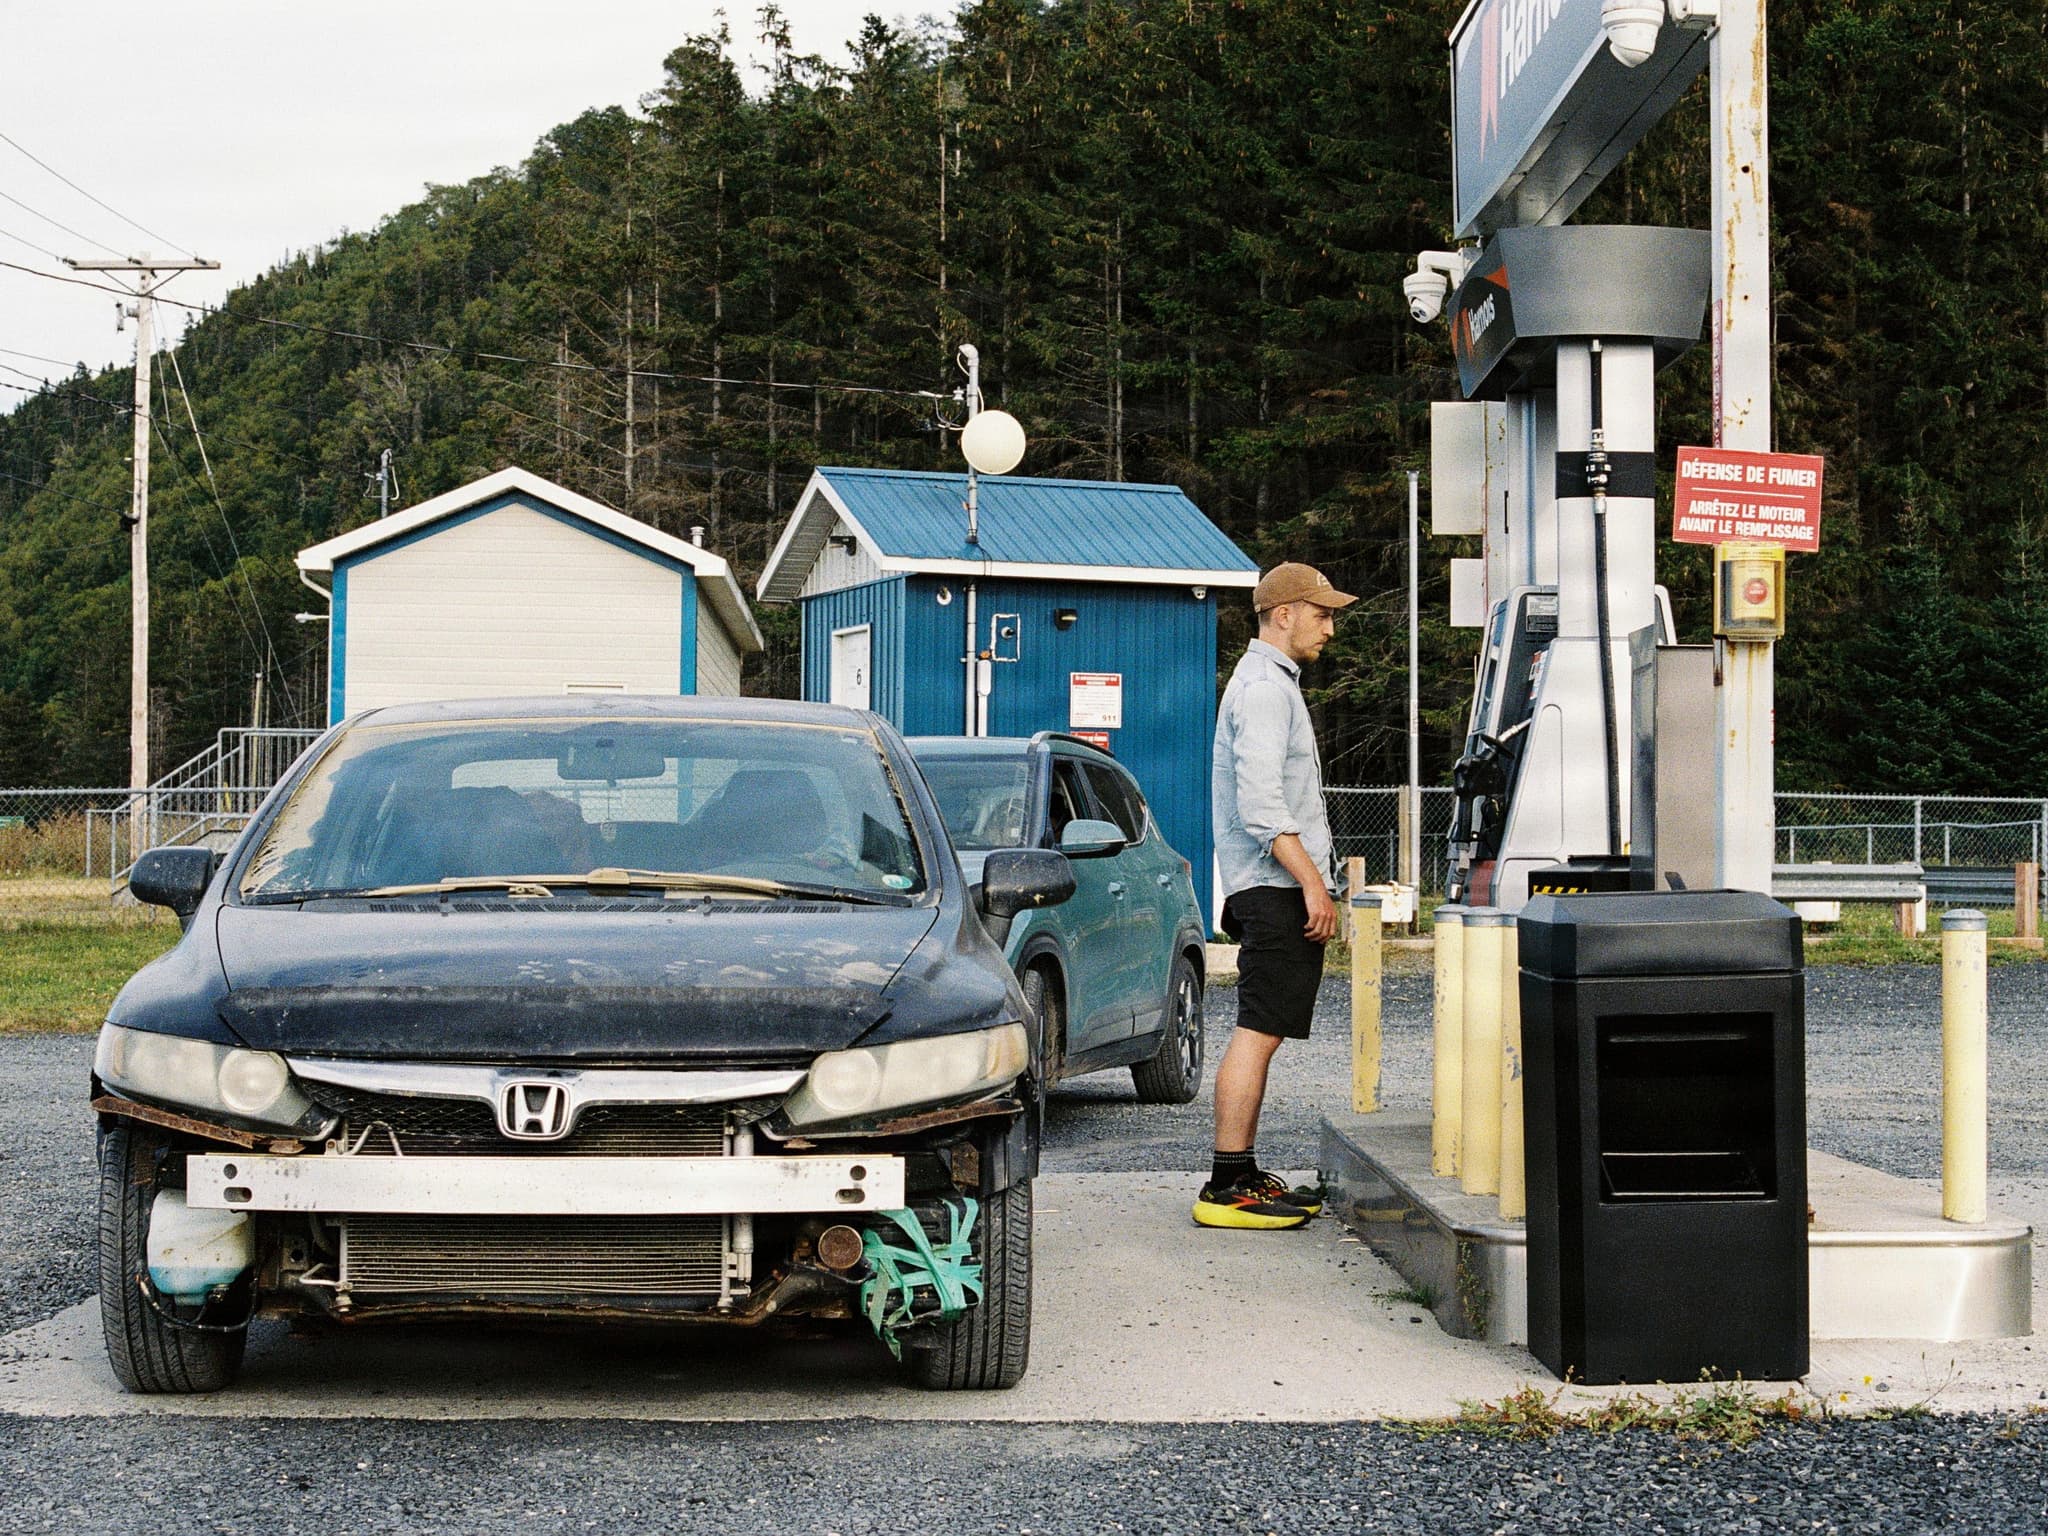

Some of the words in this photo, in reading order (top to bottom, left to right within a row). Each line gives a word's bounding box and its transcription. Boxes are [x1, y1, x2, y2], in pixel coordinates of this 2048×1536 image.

[1500, 0, 1561, 99] Harn
[1681, 458, 1742, 482] DÉFENSE
[1746, 466, 1765, 483] DE
[1768, 467, 1816, 487] FUMER
[1688, 498, 1740, 518] ARRÊTEZ
[1742, 504, 1755, 518] LE
[1759, 505, 1805, 522] MOTEUR
[1679, 517, 1716, 533] AVANT
[1719, 520, 1732, 534] LE
[1735, 521, 1814, 540] REMPLISSAGE
[856, 668, 862, 686] 6
